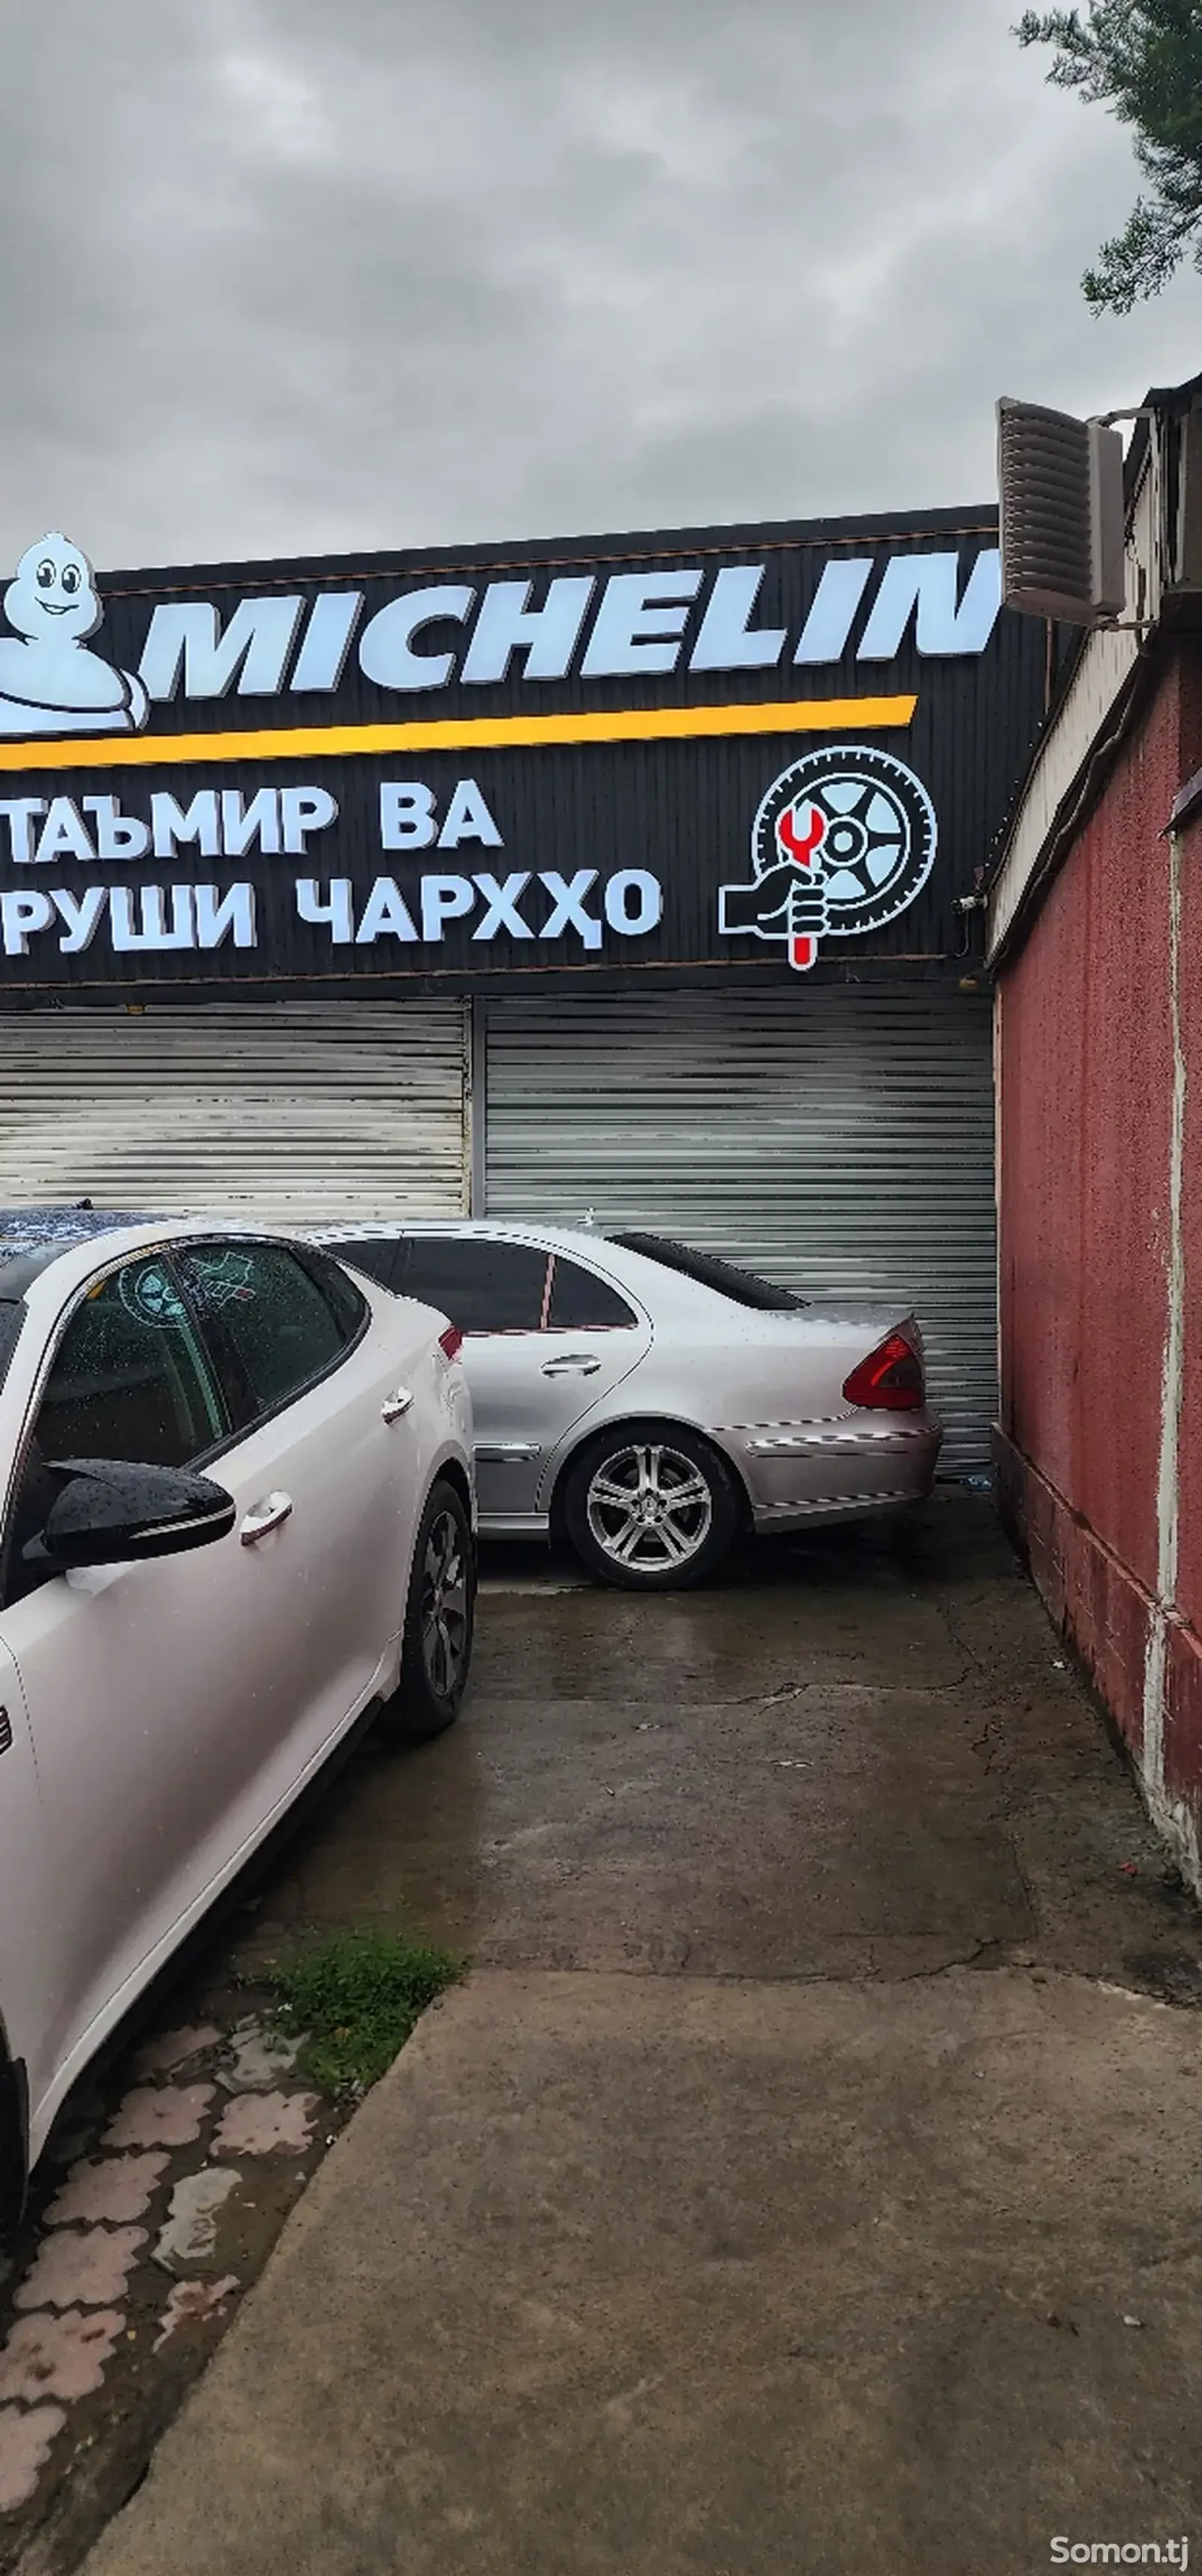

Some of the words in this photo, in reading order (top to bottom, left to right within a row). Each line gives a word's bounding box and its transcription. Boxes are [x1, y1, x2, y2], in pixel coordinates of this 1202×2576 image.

[139, 548, 1002, 702] MICHELIN
[0, 785, 339, 863] ТАЪМИР
[379, 779, 504, 850] ВА
[296, 869, 663, 950] ЧАРХҲО
